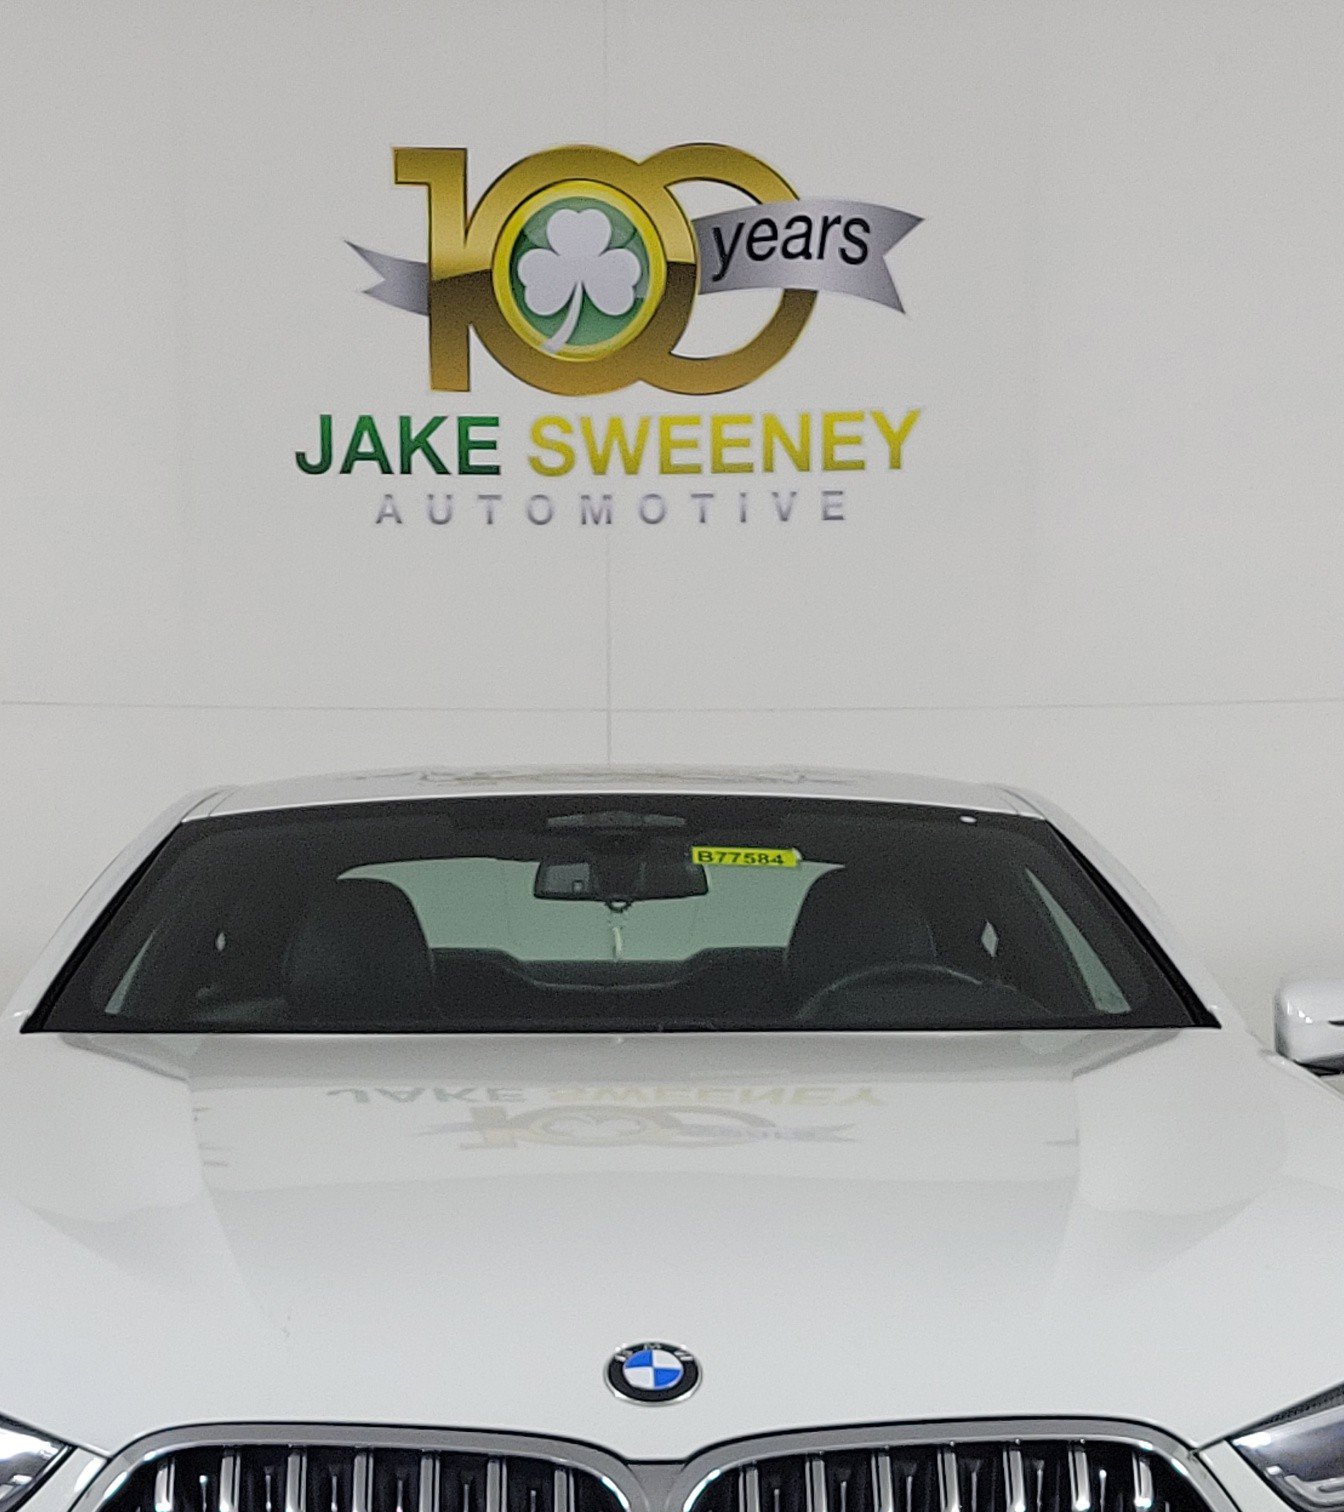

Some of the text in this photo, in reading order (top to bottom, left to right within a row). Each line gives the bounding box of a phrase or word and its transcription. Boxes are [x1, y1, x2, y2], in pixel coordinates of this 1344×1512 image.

[391, 143, 872, 397] 100 years
[294, 408, 923, 476] JAKE SWEENEY
[375, 491, 846, 525] AUTOMOTIVE
[697, 850, 784, 865] B77584
